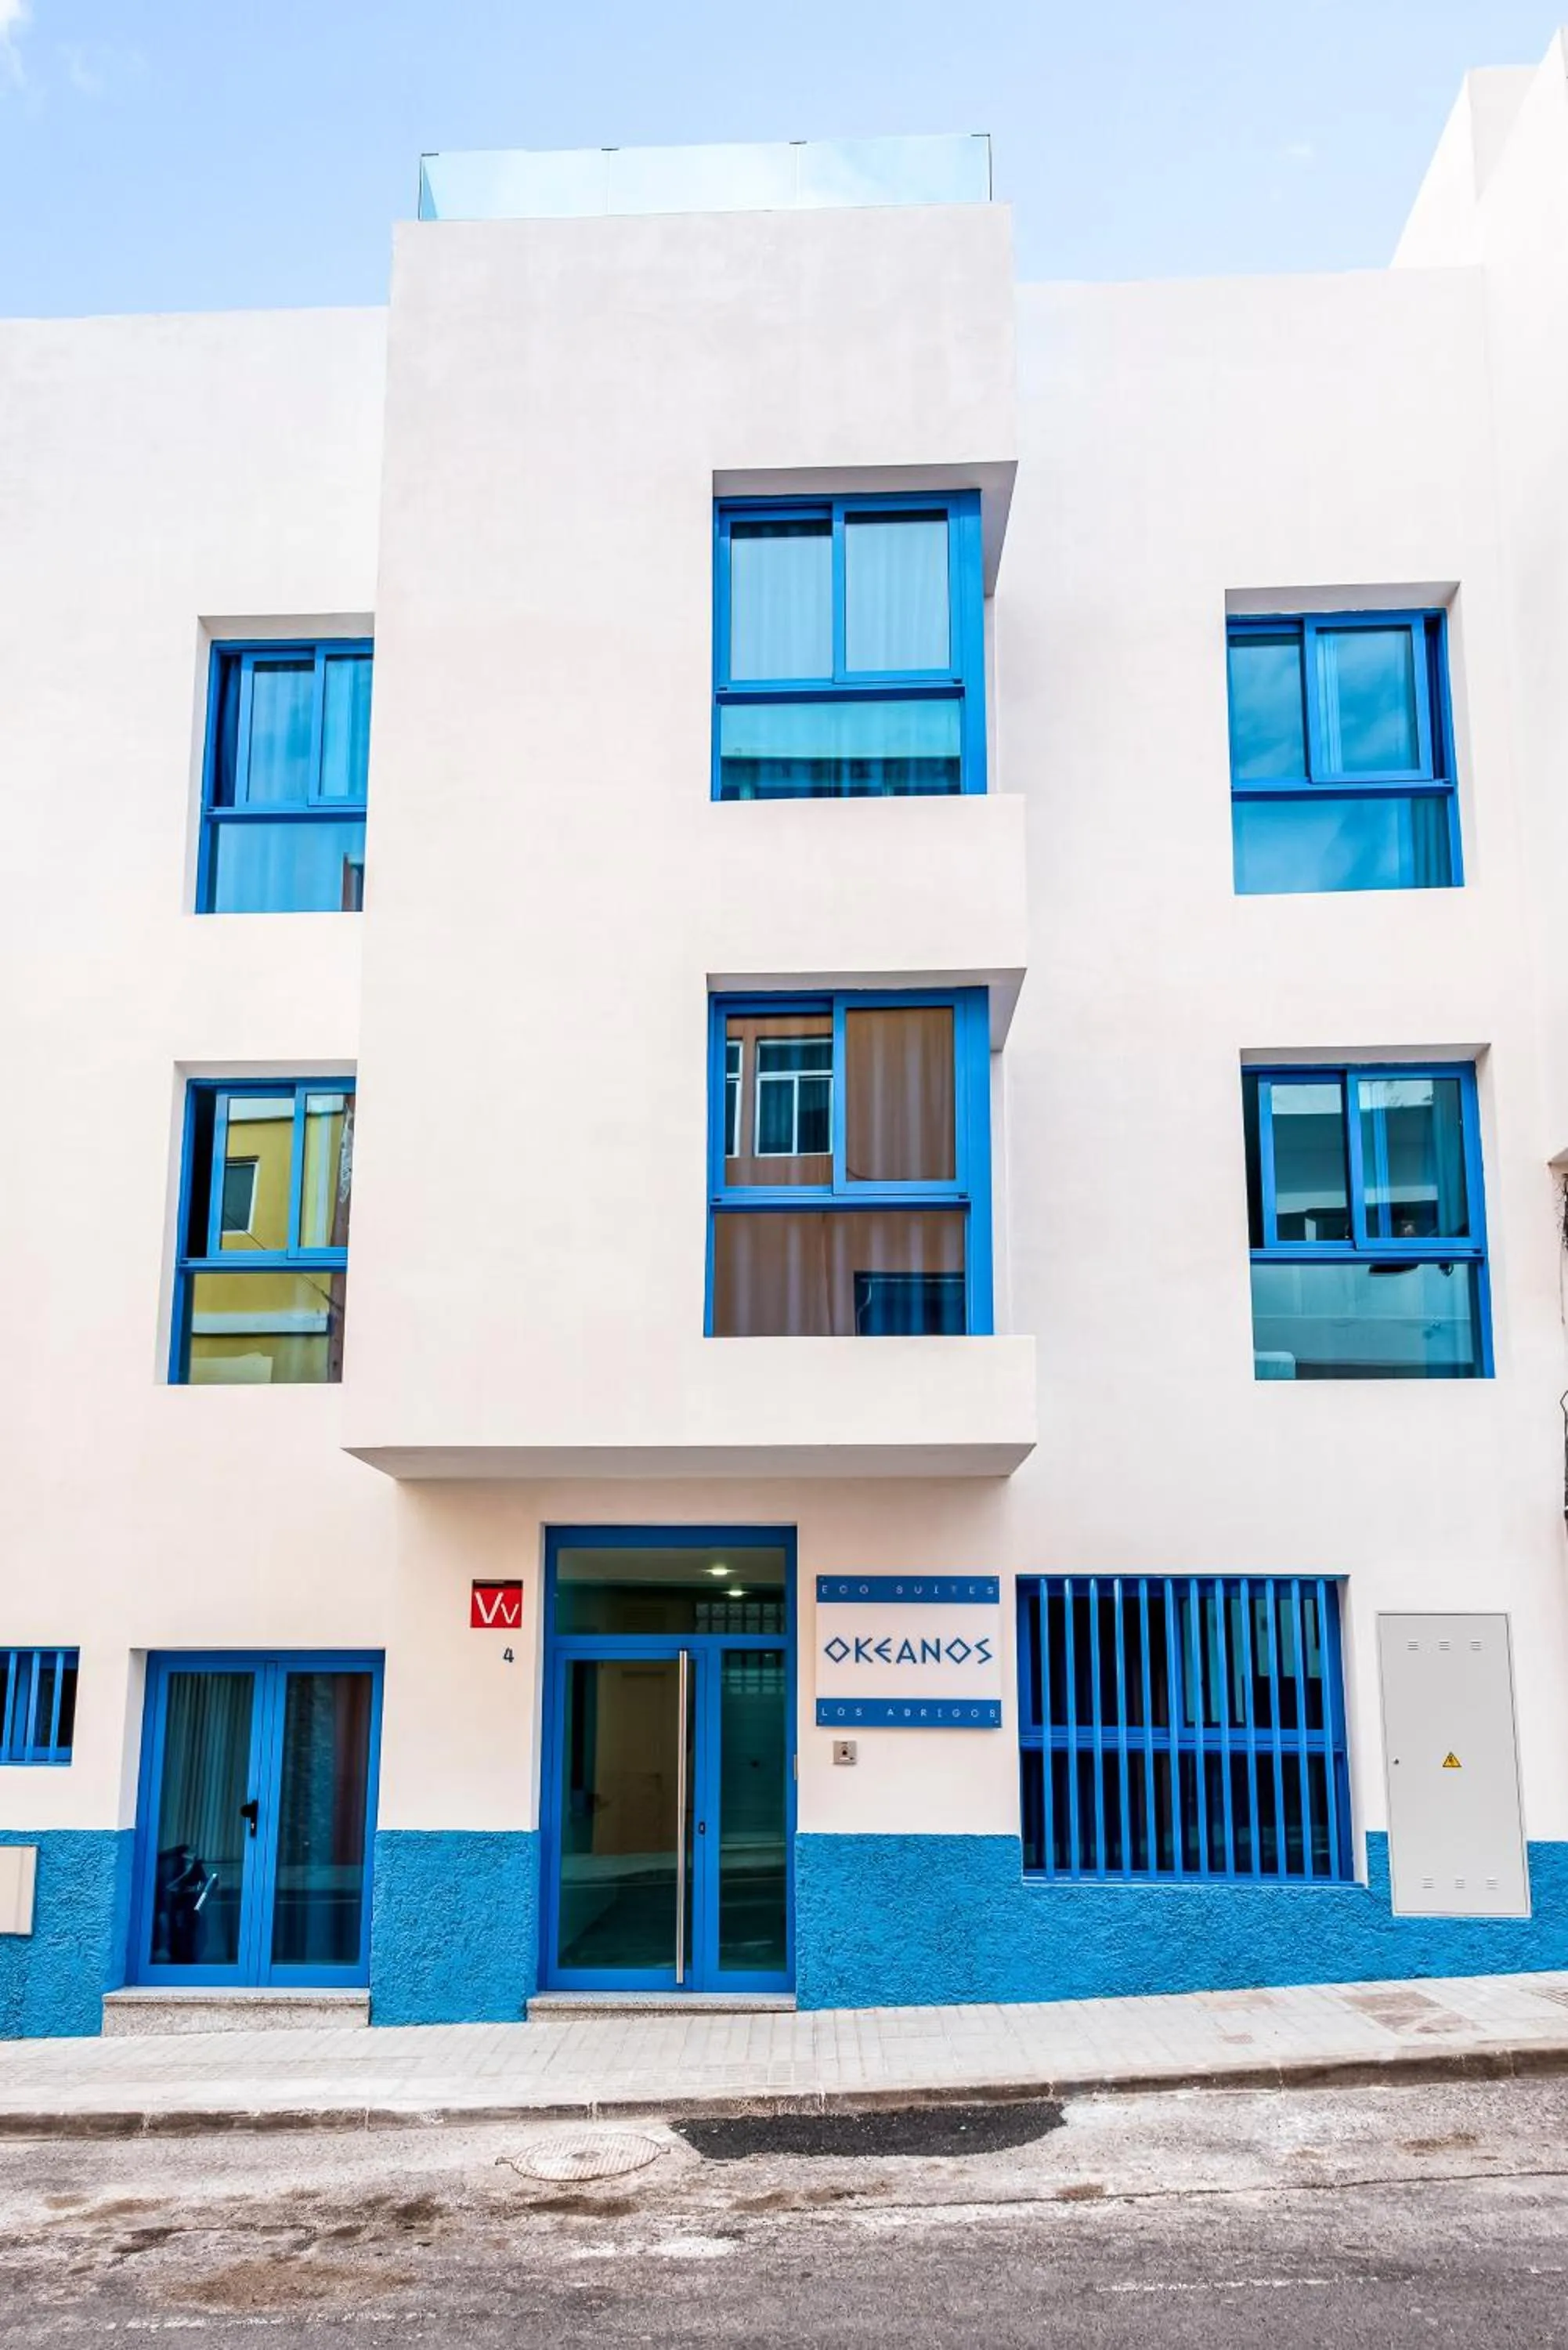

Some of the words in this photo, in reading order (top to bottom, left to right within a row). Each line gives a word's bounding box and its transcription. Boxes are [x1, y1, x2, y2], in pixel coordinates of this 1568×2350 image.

[822, 1585, 869, 1595] ECO
[895, 1585, 995, 1595] SUITES
[503, 1647, 515, 1663] 4
[825, 1637, 992, 1664] OKEANOS
[822, 1708, 862, 1716] LOS
[887, 1708, 996, 1717] ABRIGOS
